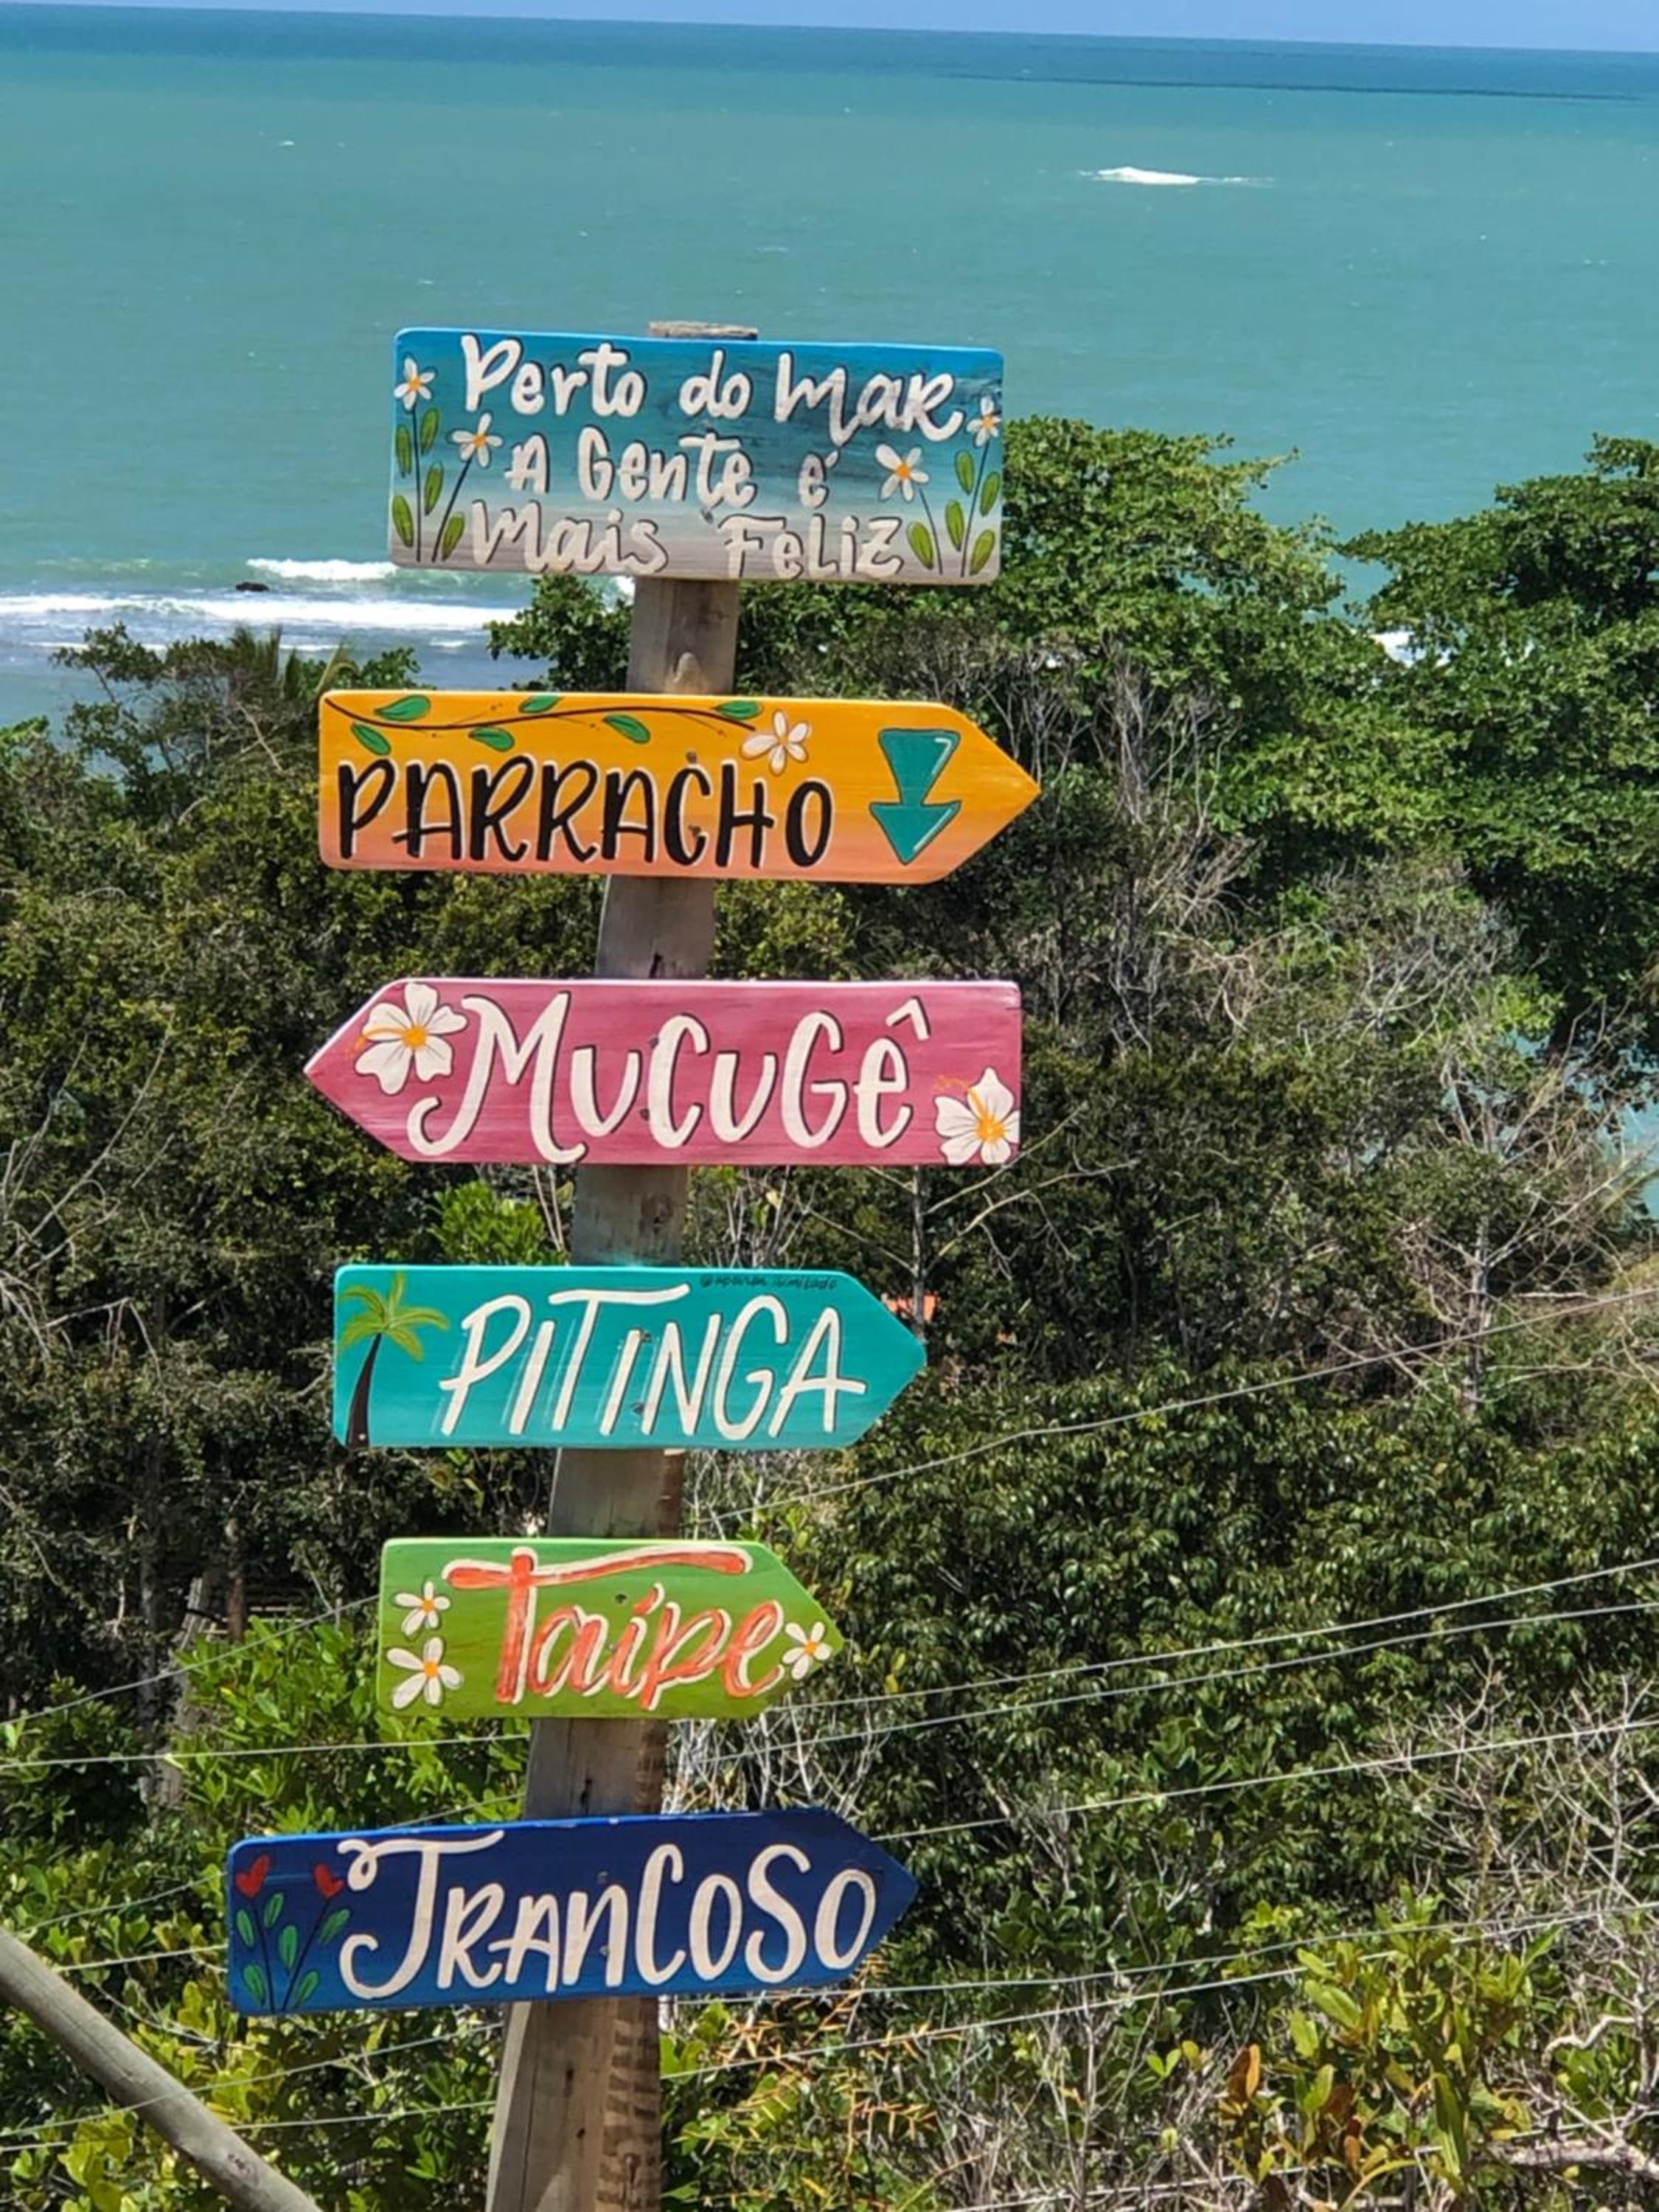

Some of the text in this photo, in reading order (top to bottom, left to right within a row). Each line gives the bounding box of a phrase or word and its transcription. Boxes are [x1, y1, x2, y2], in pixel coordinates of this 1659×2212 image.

[460, 333, 647, 420] Perto
[678, 349, 749, 419] do
[504, 425, 840, 509] A Gente é
[472, 499, 669, 574] Mais
[339, 754, 832, 868] PARRACHO
[440, 1284, 868, 1440] PITINGA
[441, 1547, 785, 1711] Taipe
